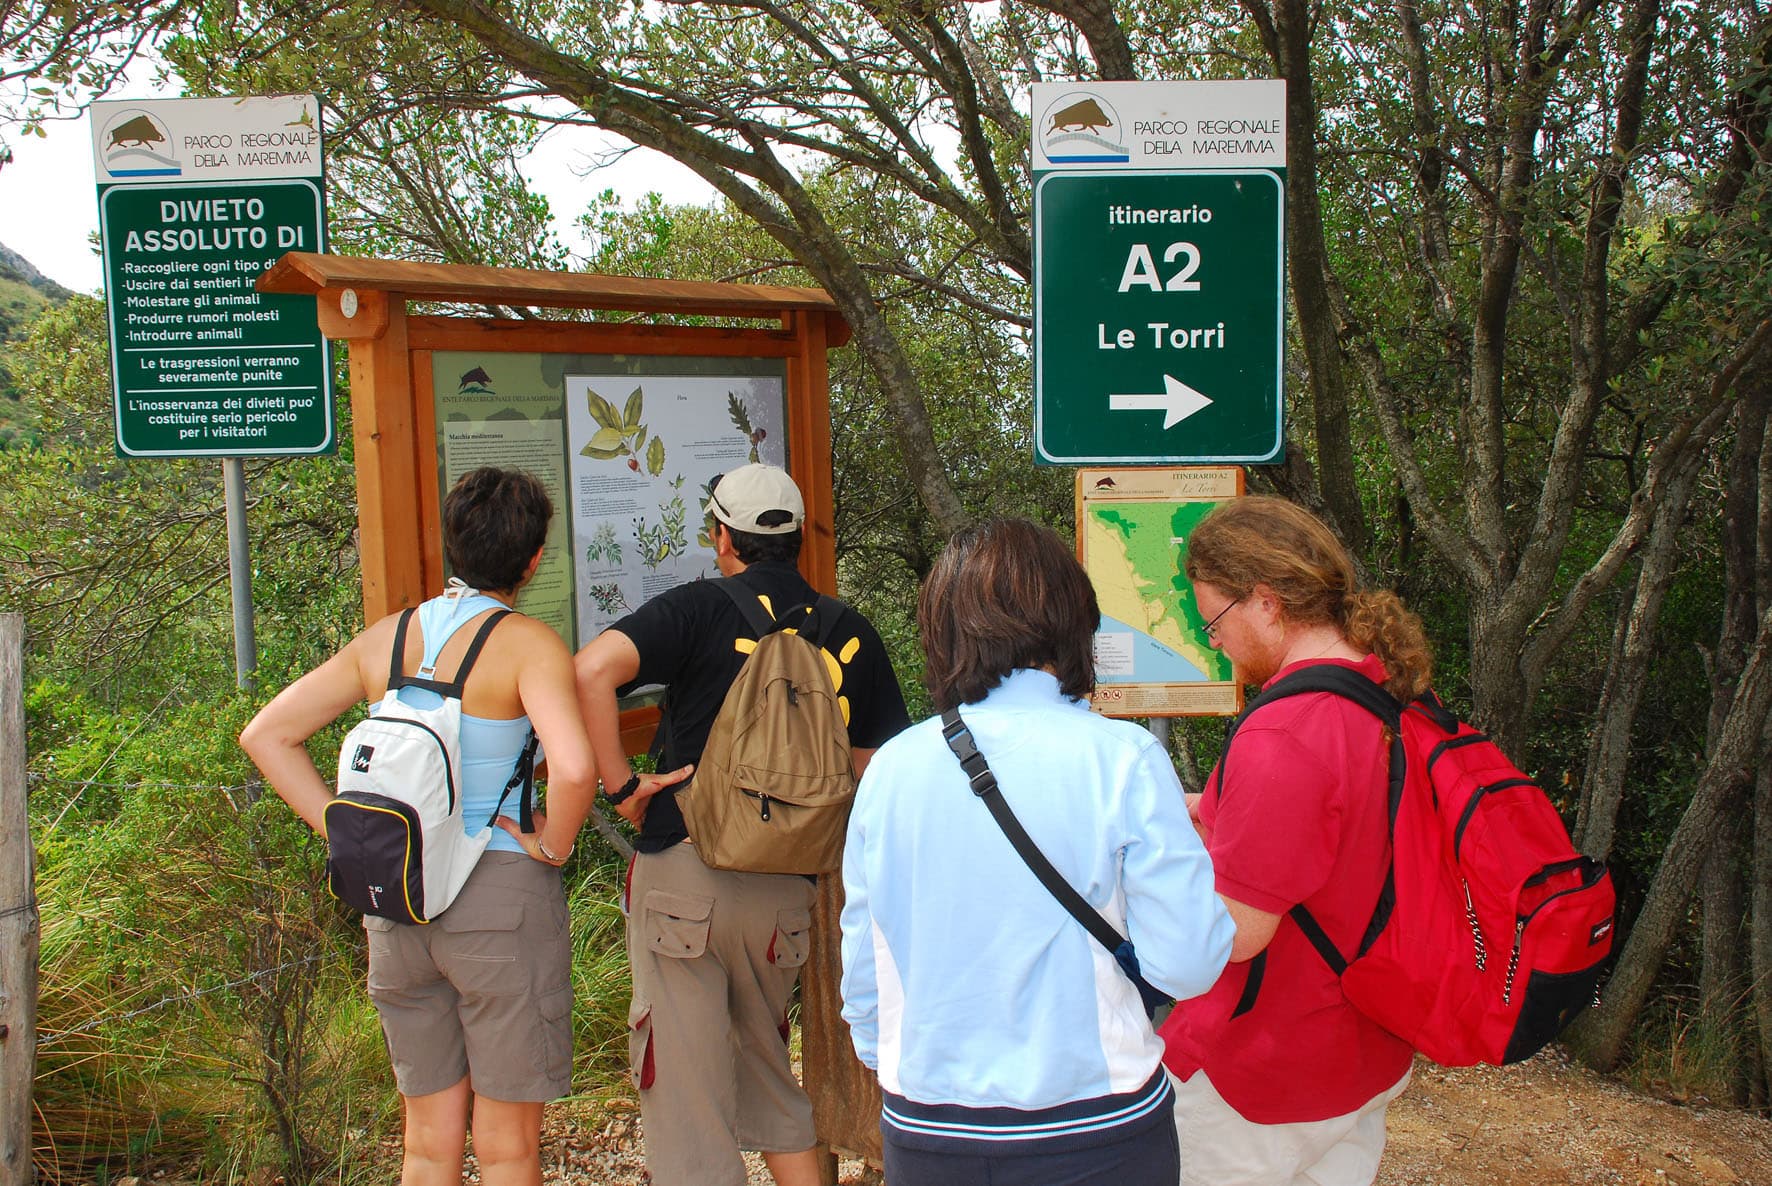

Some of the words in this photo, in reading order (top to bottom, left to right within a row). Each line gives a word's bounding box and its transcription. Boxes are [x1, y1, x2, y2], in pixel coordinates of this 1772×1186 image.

[1134, 120, 1188, 135] PARCO
[1197, 120, 1280, 134] REGIONALE
[184, 135, 232, 150] PARCO
[241, 132, 316, 147] REGIONALE
[1144, 141, 1182, 155] DELLA
[1193, 140, 1275, 154] MAREMMA
[194, 154, 229, 168] DELLA
[238, 151, 312, 166] MAREMMA
[160, 198, 264, 223] DIVIETO
[1109, 204, 1213, 224] itinerario
[124, 226, 268, 252] ASSOLUTO
[278, 226, 304, 248] DI
[203, 260, 230, 273] ogni
[234, 259, 260, 272] tipo
[1118, 242, 1200, 292] A2
[170, 278, 190, 290] dai
[194, 277, 241, 289] sentieri
[194, 294, 210, 308] gli
[214, 293, 260, 306] animali
[187, 311, 228, 323] rumori
[232, 310, 280, 322] molesti
[197, 328, 242, 340] animali
[1098, 323, 1136, 349] Le
[1148, 322, 1225, 349] Torri
[140, 358, 156, 369] Le
[159, 356, 240, 370] trasgressioni
[244, 356, 300, 367] verranno
[158, 371, 238, 383] severamente
[242, 370, 282, 383] punite
[129, 400, 218, 411] L'inosservanza
[223, 398, 242, 409] dei
[246, 397, 285, 408] divieti
[289, 396, 316, 410] puo'
[148, 413, 208, 424] costituire
[212, 412, 242, 423] serio
[246, 410, 297, 424] pericolo
[179, 428, 199, 439] per
[204, 427, 208, 437] i
[212, 425, 267, 437] visitatori
